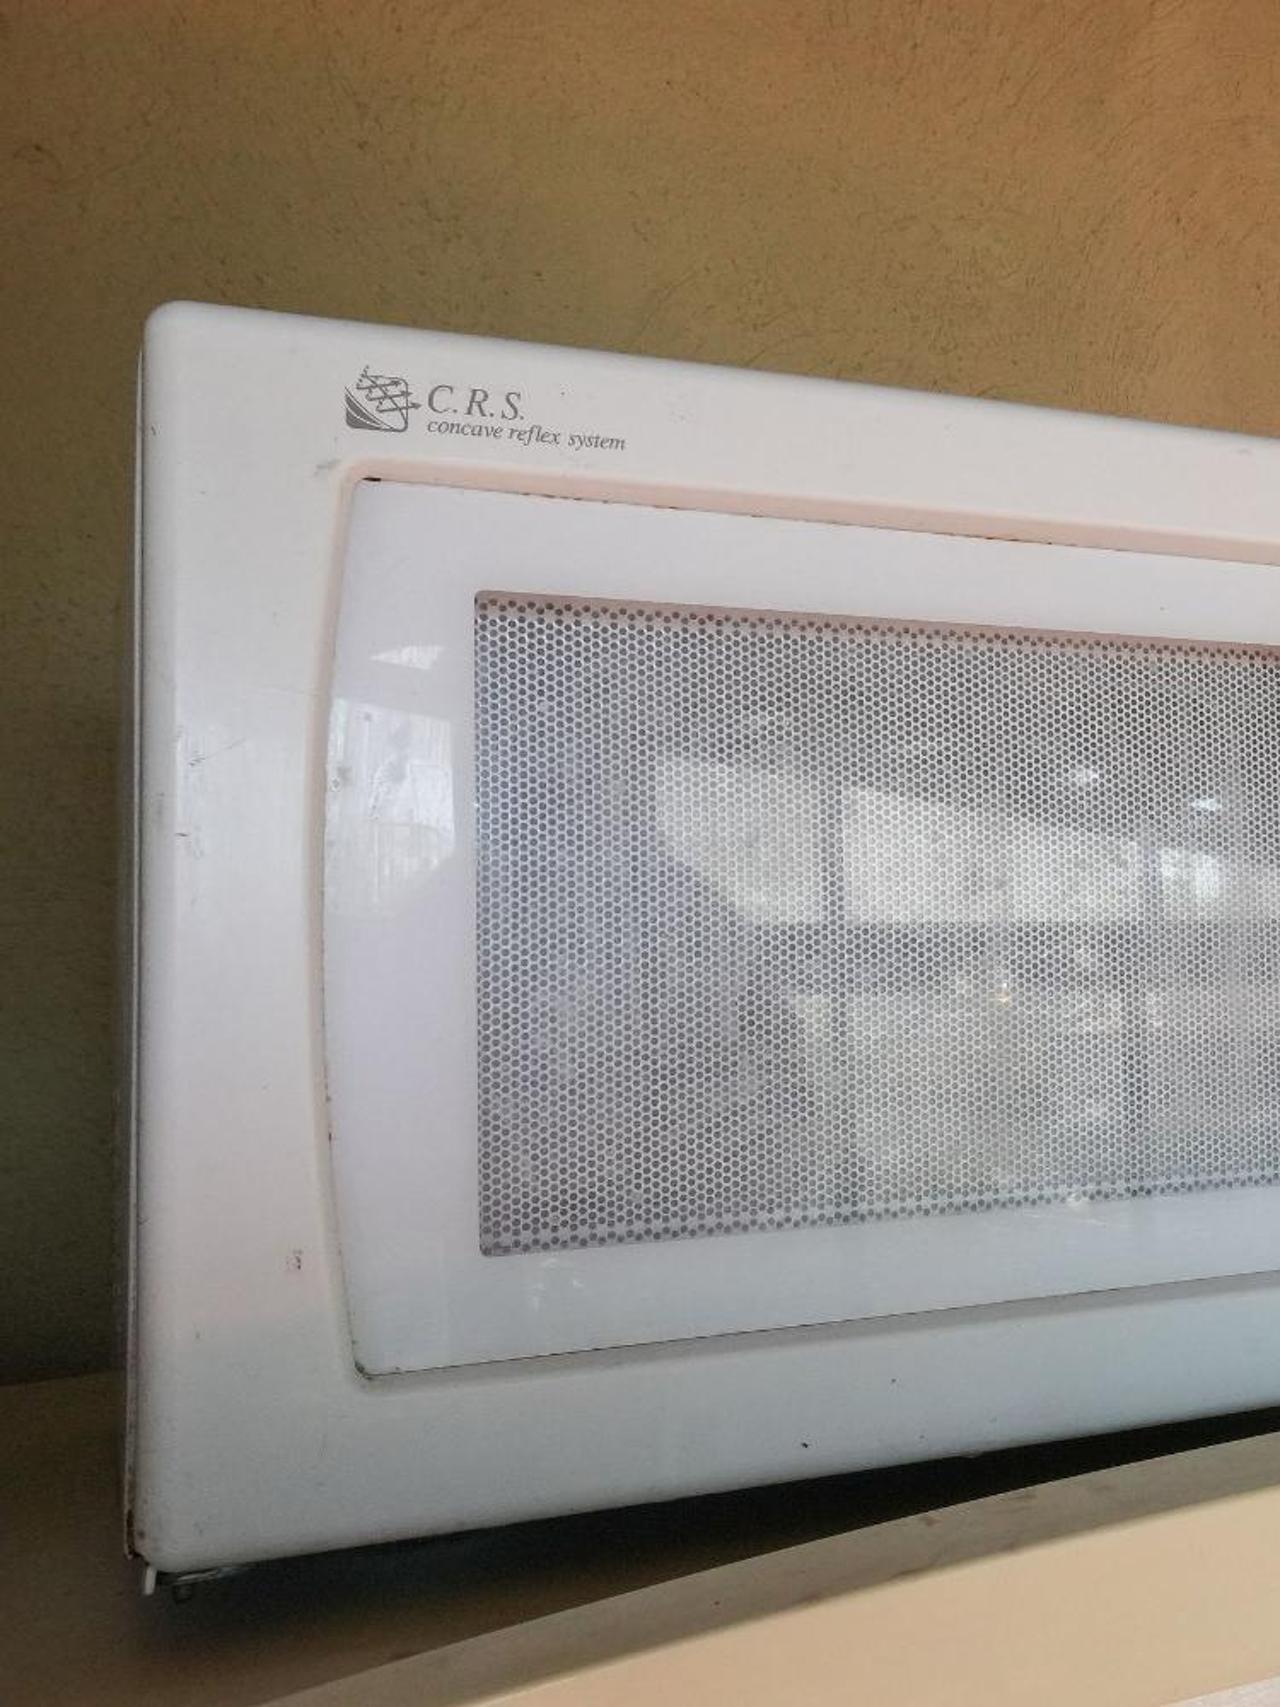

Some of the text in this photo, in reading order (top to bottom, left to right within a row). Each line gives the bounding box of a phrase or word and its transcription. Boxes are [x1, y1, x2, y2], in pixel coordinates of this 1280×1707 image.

[427, 419, 626, 450] concave reflex system
